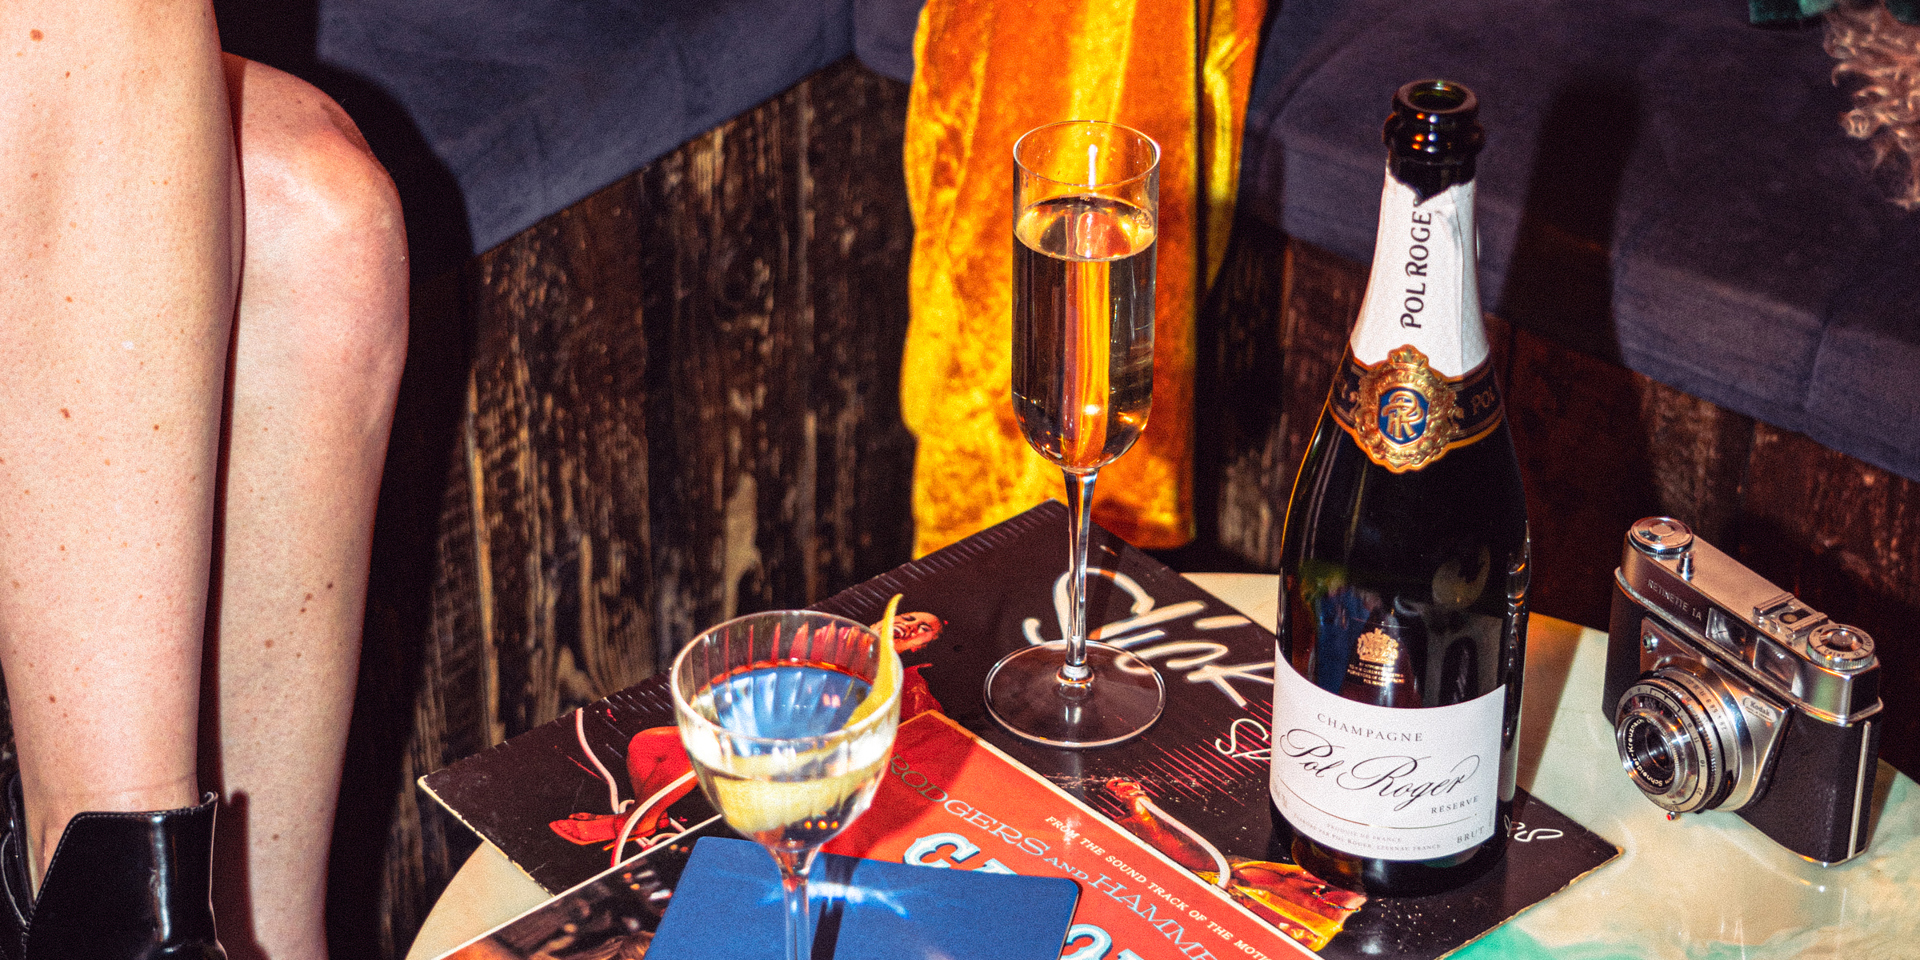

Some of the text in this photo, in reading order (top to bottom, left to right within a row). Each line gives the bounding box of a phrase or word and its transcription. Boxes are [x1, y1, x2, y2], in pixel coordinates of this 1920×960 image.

[1399, 283, 1426, 329] POL
[1317, 713, 1423, 742] CHAMPAGNE
[1280, 728, 1345, 777] Pol
[1336, 754, 1480, 812] Roger
[889, 751, 1051, 856] RODGERS
[1043, 857, 1089, 880] AND
[1457, 825, 1485, 843] BRUT
[1045, 815, 1080, 839] FROM
[1079, 837, 1106, 856] THE
[1105, 854, 1147, 883] SOUND
[1147, 881, 1190, 911] TRACK
[1188, 909, 1208, 921] OF
[1206, 920, 1234, 940] THE
